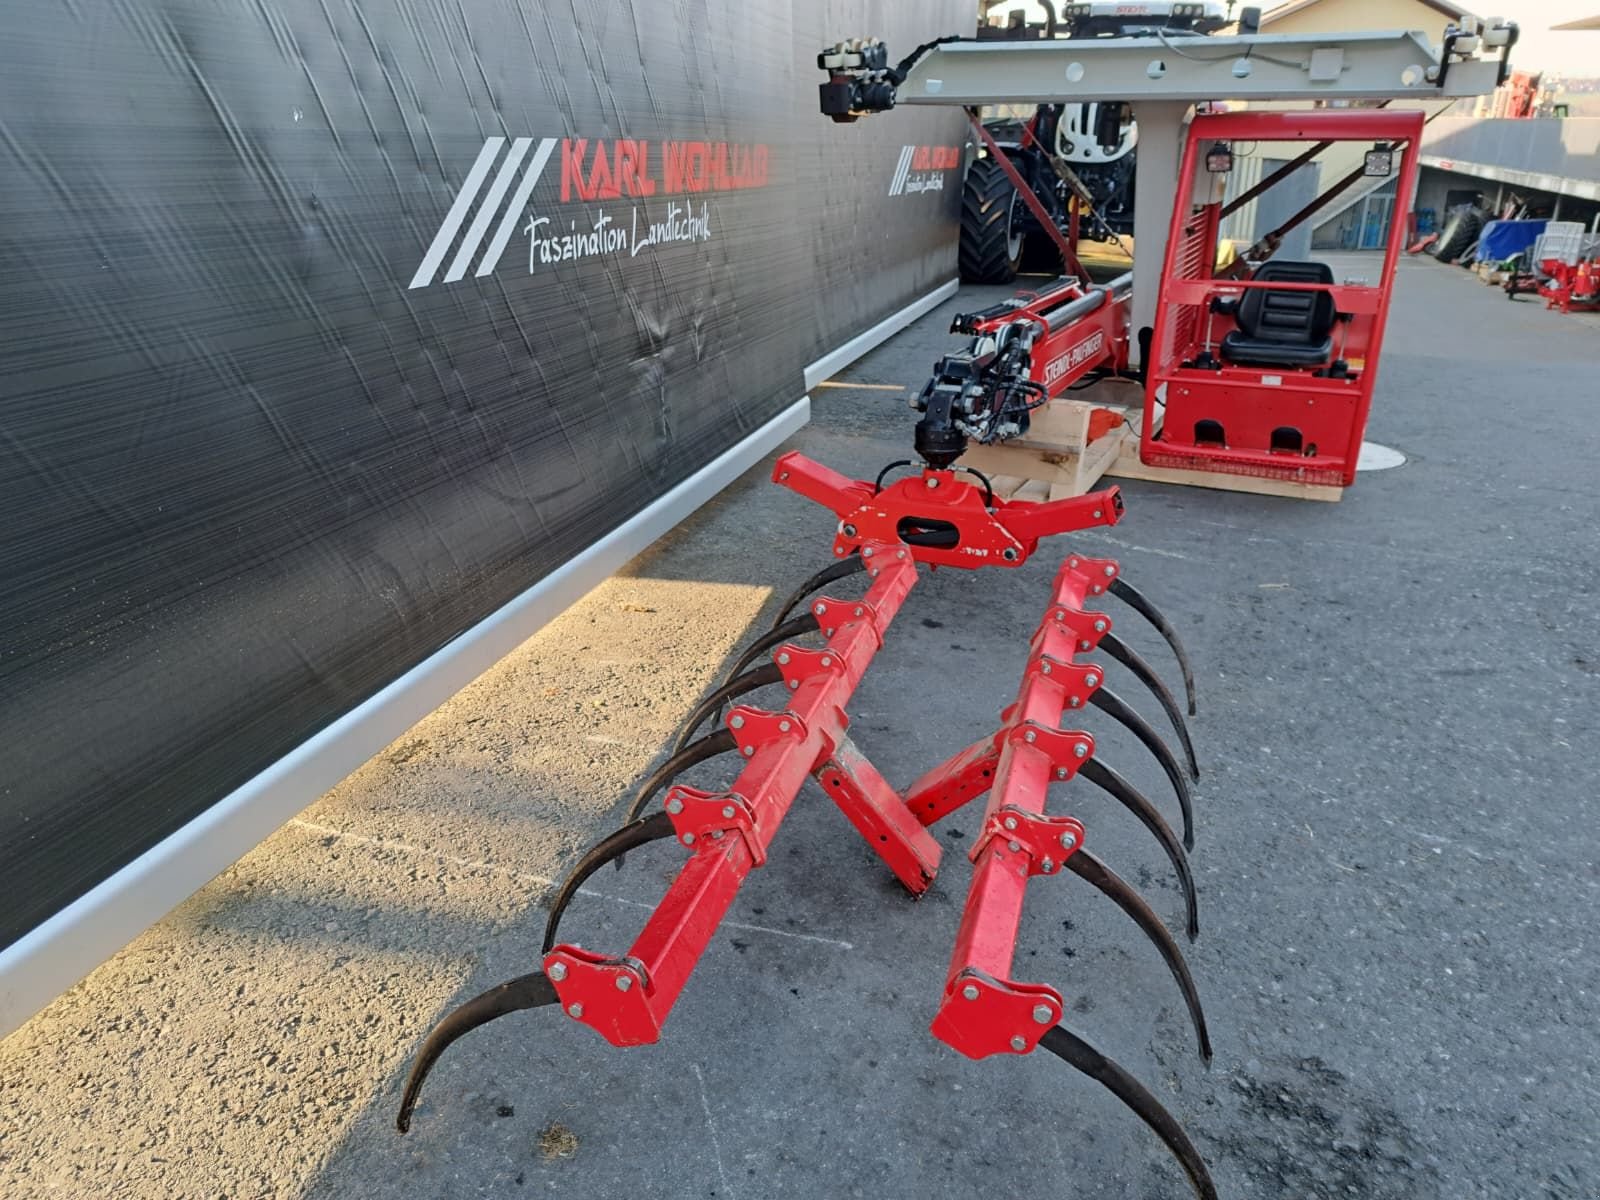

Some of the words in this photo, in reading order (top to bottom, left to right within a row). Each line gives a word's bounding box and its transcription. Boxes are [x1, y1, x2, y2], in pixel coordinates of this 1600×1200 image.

[560, 137, 656, 203] KARL
[524, 207, 627, 275] Faszination
[631, 199, 711, 257] Landtechnik
